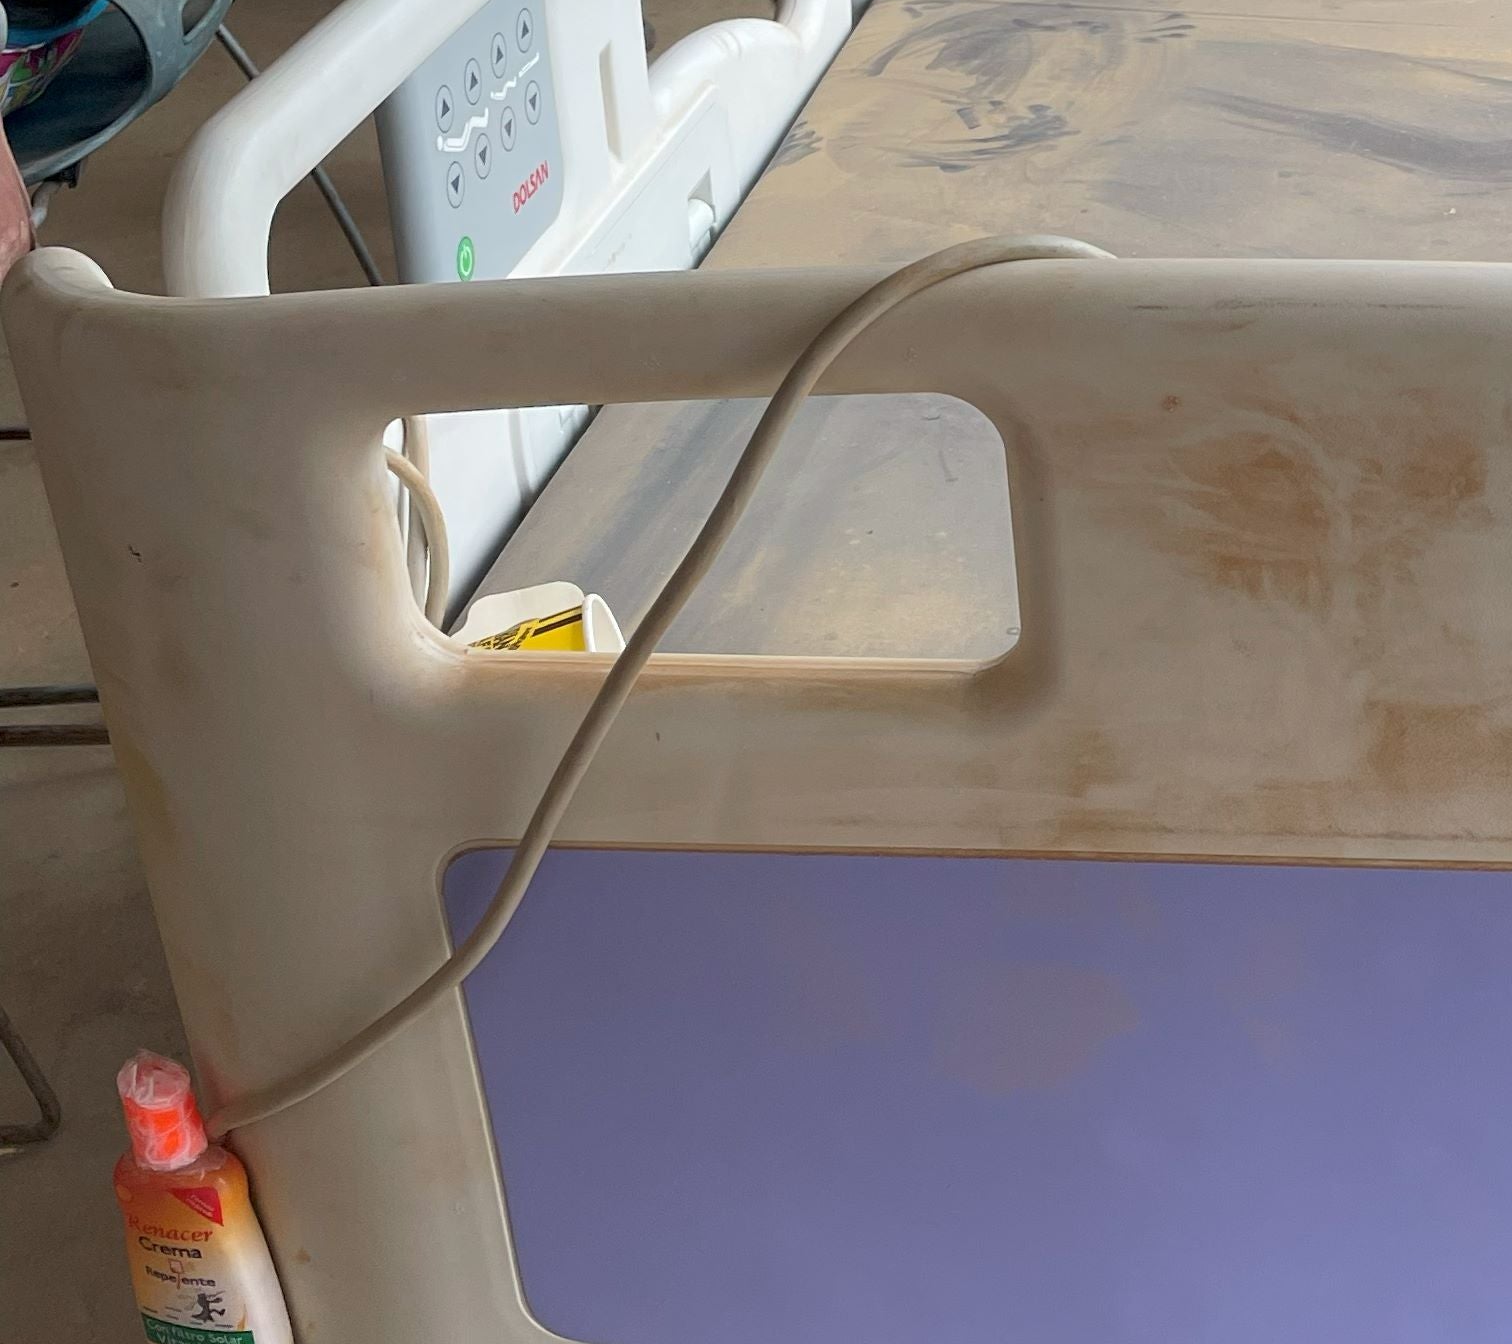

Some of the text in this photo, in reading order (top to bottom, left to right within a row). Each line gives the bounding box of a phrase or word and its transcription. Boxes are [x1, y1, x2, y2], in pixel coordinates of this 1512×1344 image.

[512, 160, 550, 215] DOLSAN
[128, 1213, 214, 1243] Renacer
[138, 1236, 202, 1259] Crema
